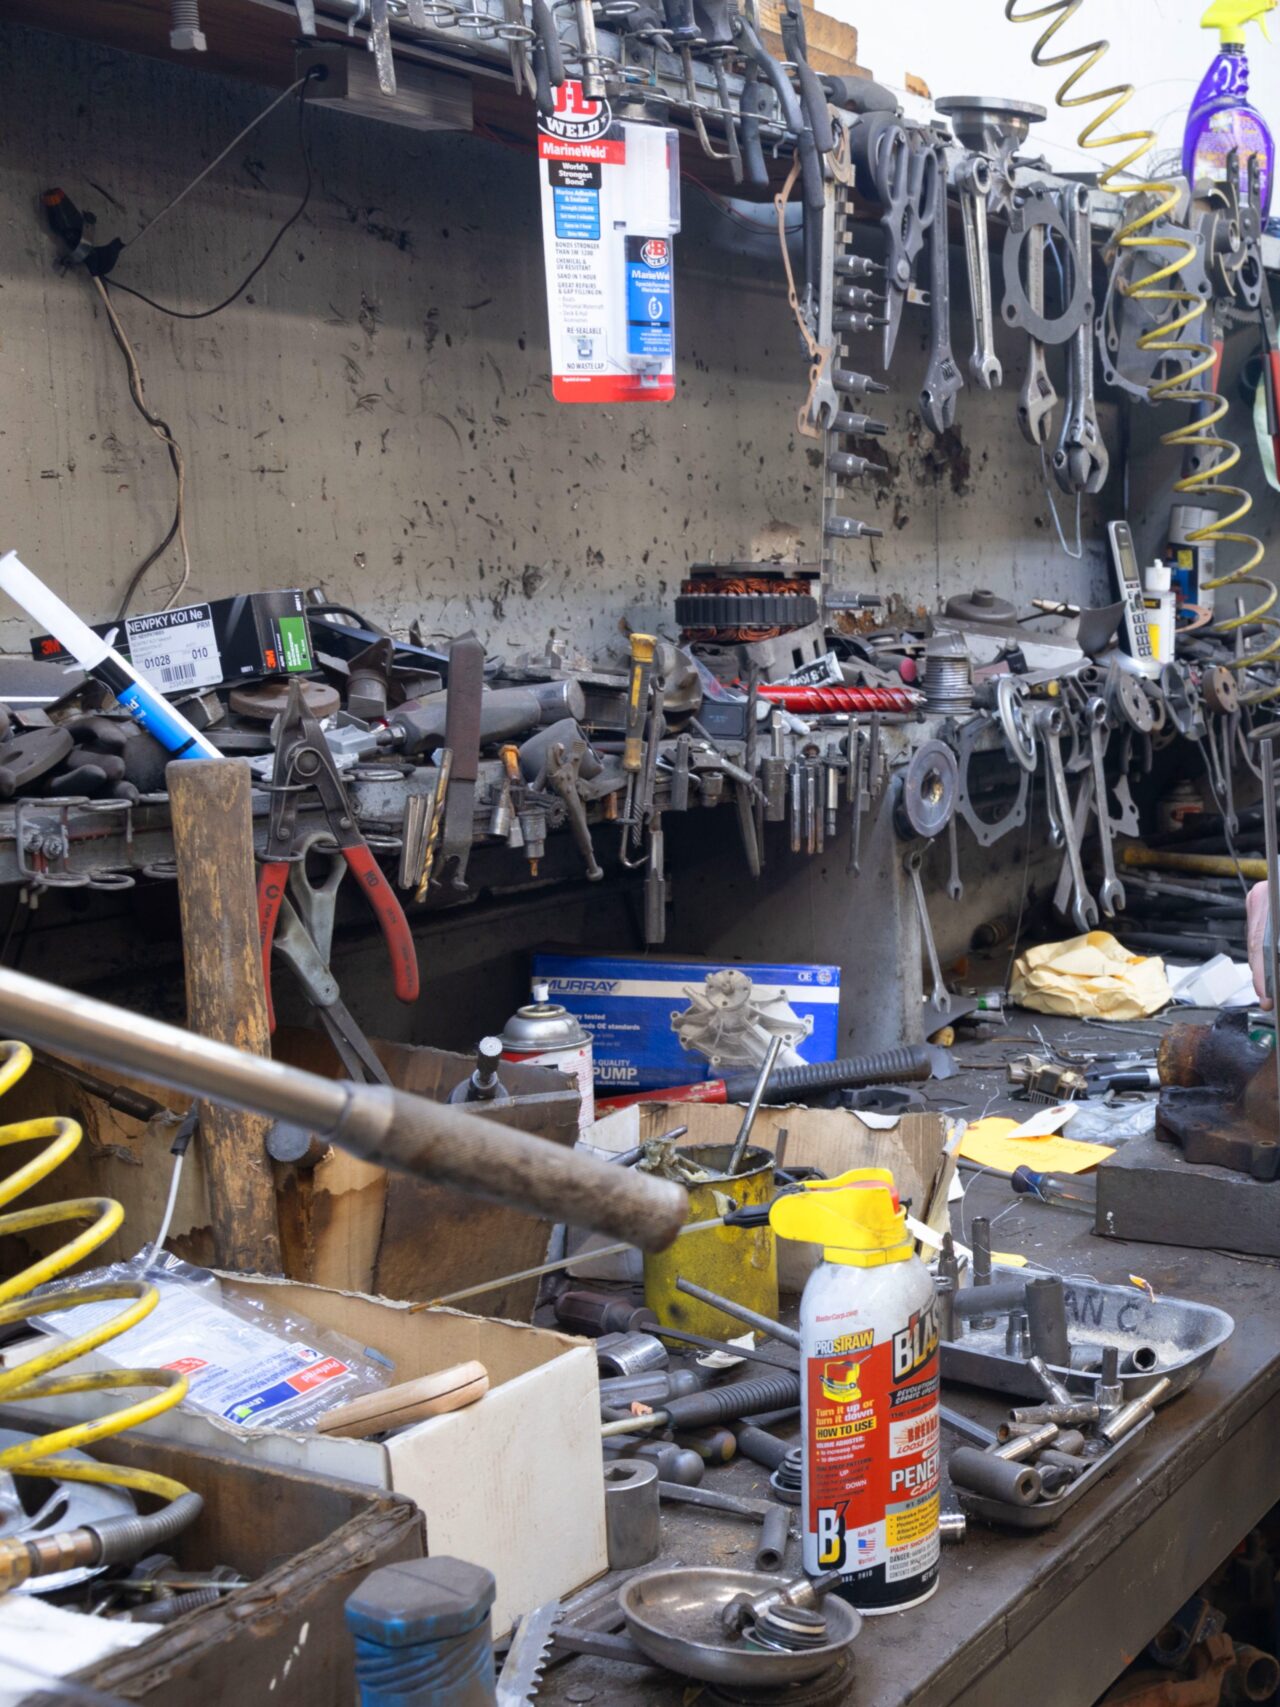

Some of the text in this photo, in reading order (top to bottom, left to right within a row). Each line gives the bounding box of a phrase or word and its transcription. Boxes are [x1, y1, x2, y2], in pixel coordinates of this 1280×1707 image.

[546, 117, 600, 138] WELD
[562, 162, 589, 171] World's
[559, 170, 593, 180] Strongest
[127, 609, 203, 633] NEWPKY KOI Ne
[41, 639, 61, 656] 3M
[191, 647, 208, 660] 010
[144, 654, 171, 669] 01028
[263, 649, 277, 670] 3M
[584, 1013, 606, 1021] tested
[607, 1023, 641, 1031] standards
[598, 1059, 631, 1067] QUALITY
[593, 1067, 638, 1081] PUMP
[816, 1330, 874, 1355] PROSTRAW
[816, 1399, 875, 1417] Turn it up or
[816, 1408, 874, 1426] turn it down
[817, 1419, 874, 1439] HOW TO USE
[839, 1469, 849, 1477] UP
[845, 1480, 867, 1490] DOWN
